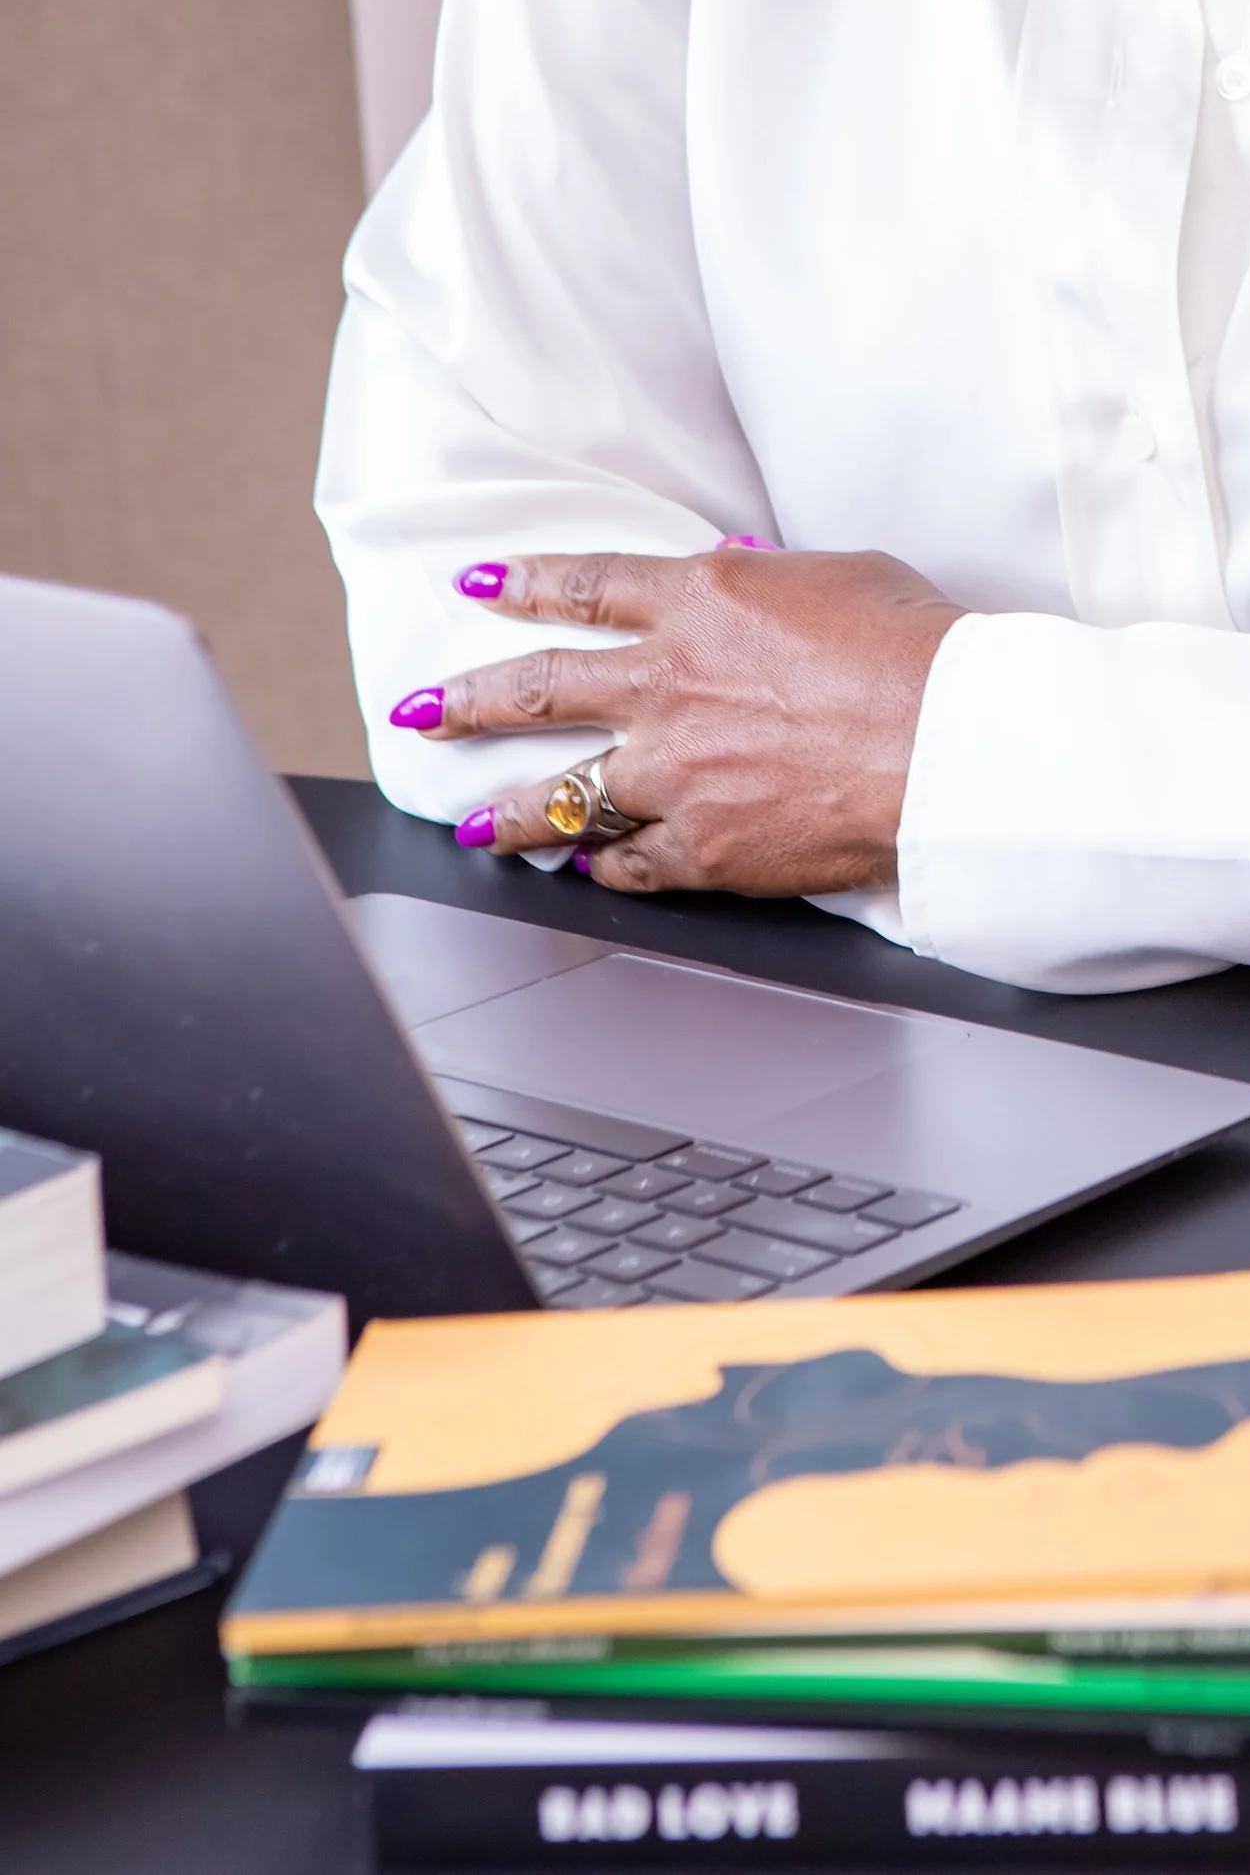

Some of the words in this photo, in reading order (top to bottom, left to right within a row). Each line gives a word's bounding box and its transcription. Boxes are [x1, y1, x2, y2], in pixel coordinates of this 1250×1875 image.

[538, 1784, 652, 1843] BAD
[656, 1780, 798, 1842] LOVE
[1104, 1773, 1239, 1835] BLUE
